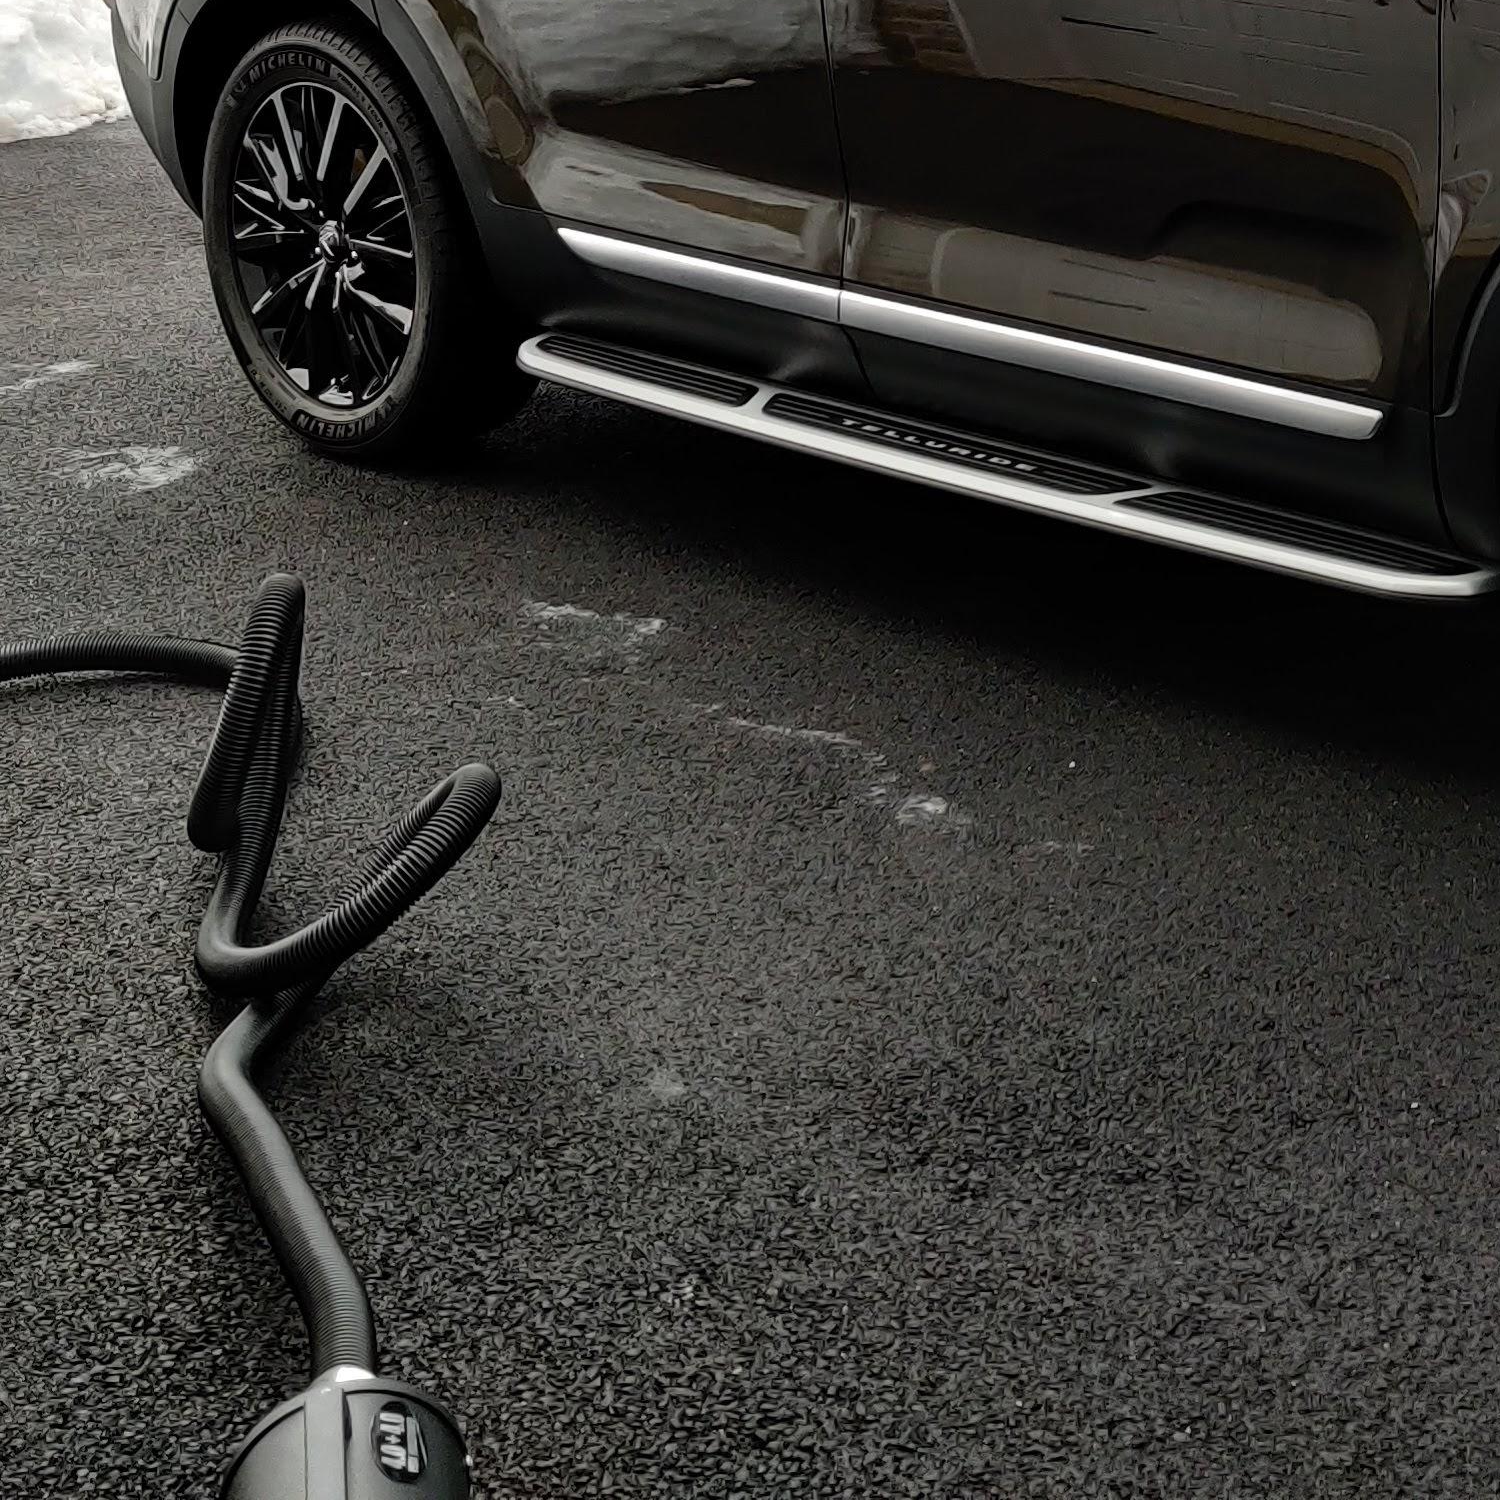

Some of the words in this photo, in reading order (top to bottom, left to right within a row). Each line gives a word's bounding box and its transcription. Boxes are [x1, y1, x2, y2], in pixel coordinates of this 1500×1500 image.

[248, 52, 326, 84] MICHELIN
[296, 412, 376, 439] MICHELIN
[841, 417, 1039, 472] TELLURIDE
